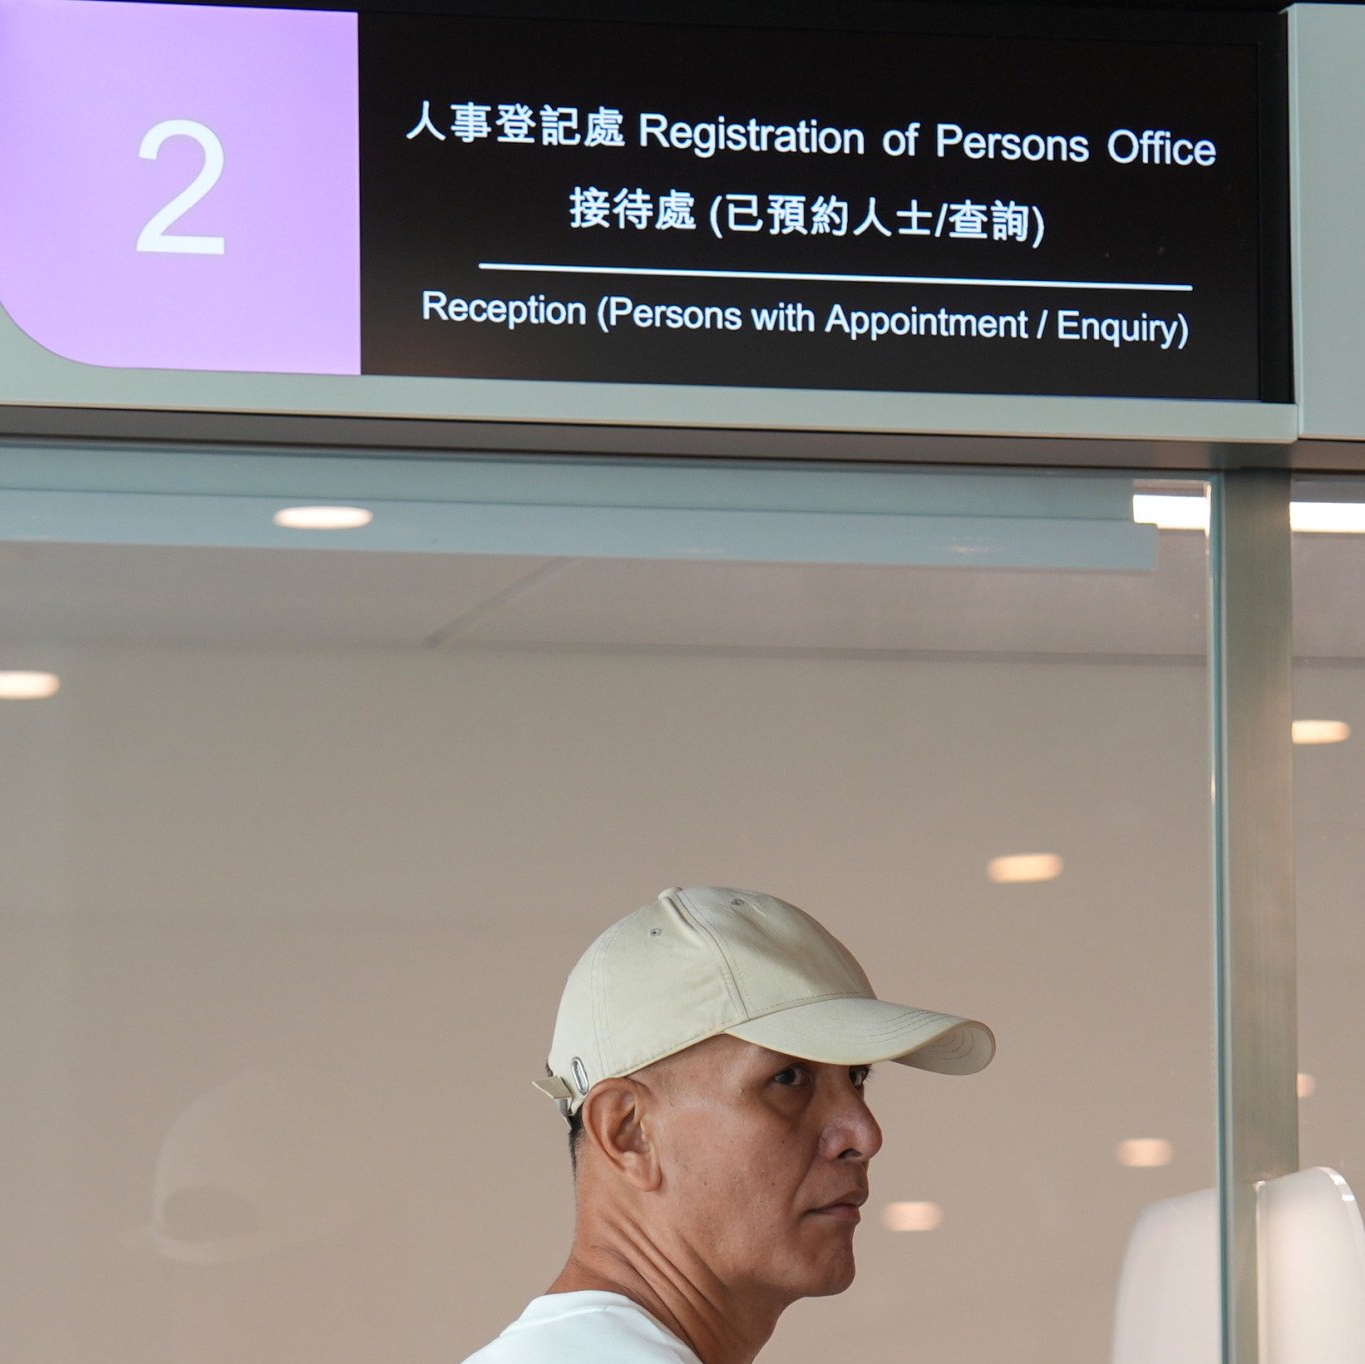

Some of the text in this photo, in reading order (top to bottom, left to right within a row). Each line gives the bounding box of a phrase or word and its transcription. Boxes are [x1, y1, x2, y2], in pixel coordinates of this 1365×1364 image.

[406, 100, 1217, 167] 人事登記處 Registration of Persons Office
[135, 119, 226, 256] 2
[569, 186, 1045, 249] 接待處 (已預約人士/查詢)
[422, 290, 1189, 350] Reception (Persons with Appointment / Enquiry)
